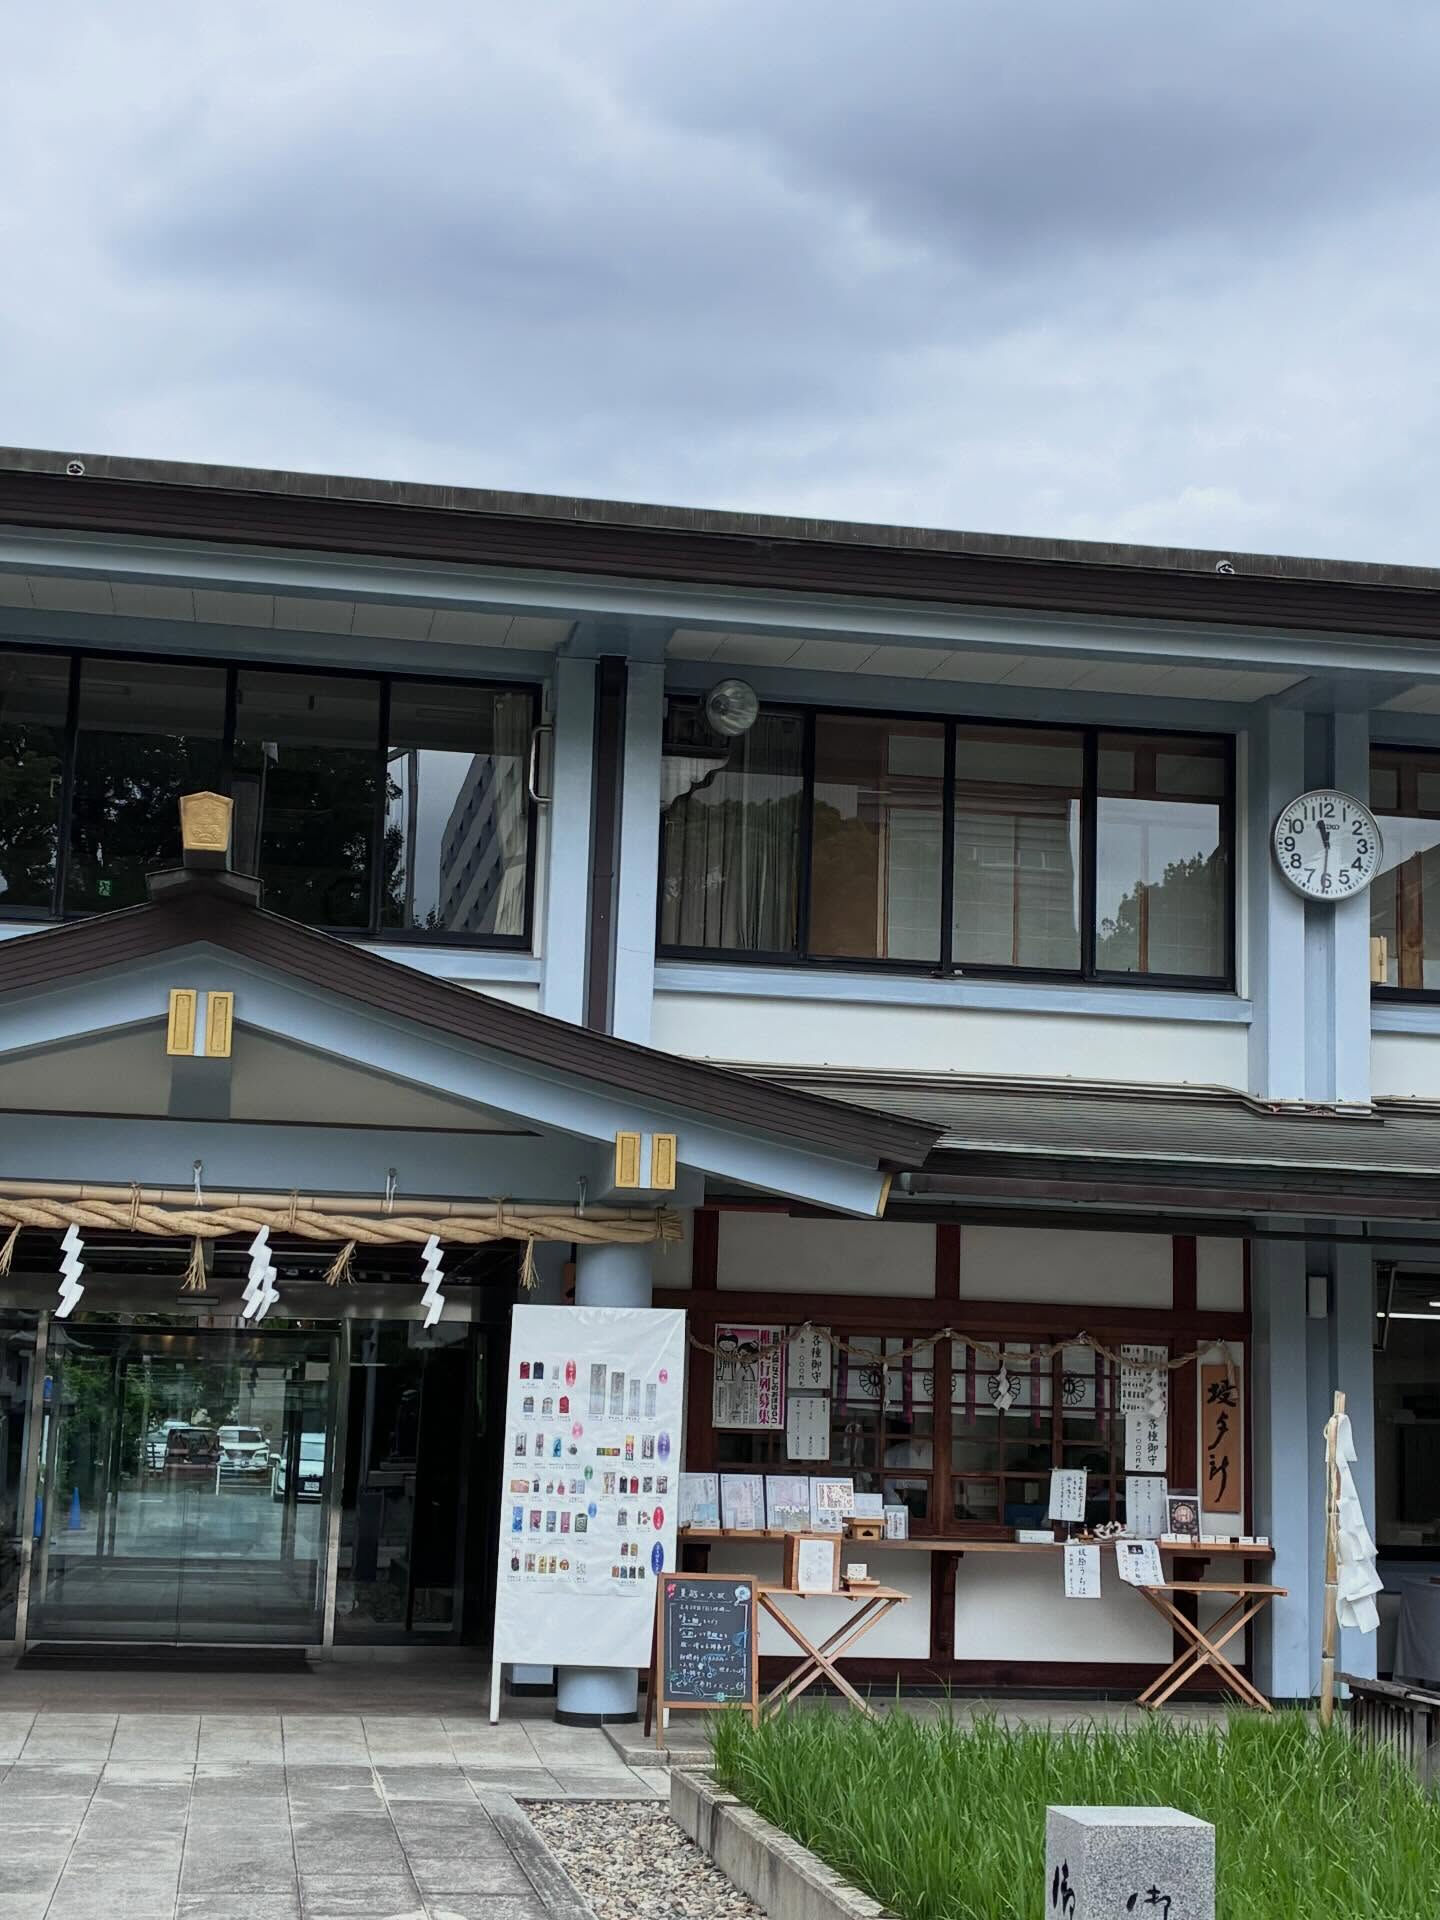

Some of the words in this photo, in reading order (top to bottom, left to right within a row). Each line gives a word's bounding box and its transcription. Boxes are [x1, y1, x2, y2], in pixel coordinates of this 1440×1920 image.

[1304, 806, 1315, 821] 11
[1319, 802, 1335, 818] 12
[1288, 818, 1304, 834] 10
[1351, 820, 1363, 836] 2
[1284, 836, 1296, 852] 9
[1356, 839, 1369, 855] 3
[1290, 853, 1302, 869] 8
[1351, 857, 1364, 872] 4
[1304, 868, 1316, 884] 7
[1320, 873, 1332, 889] 6
[1338, 869, 1350, 885] 5
[811, 1334, 823, 1384] 各種御守
[1147, 1418, 1159, 1467] 各種御守
